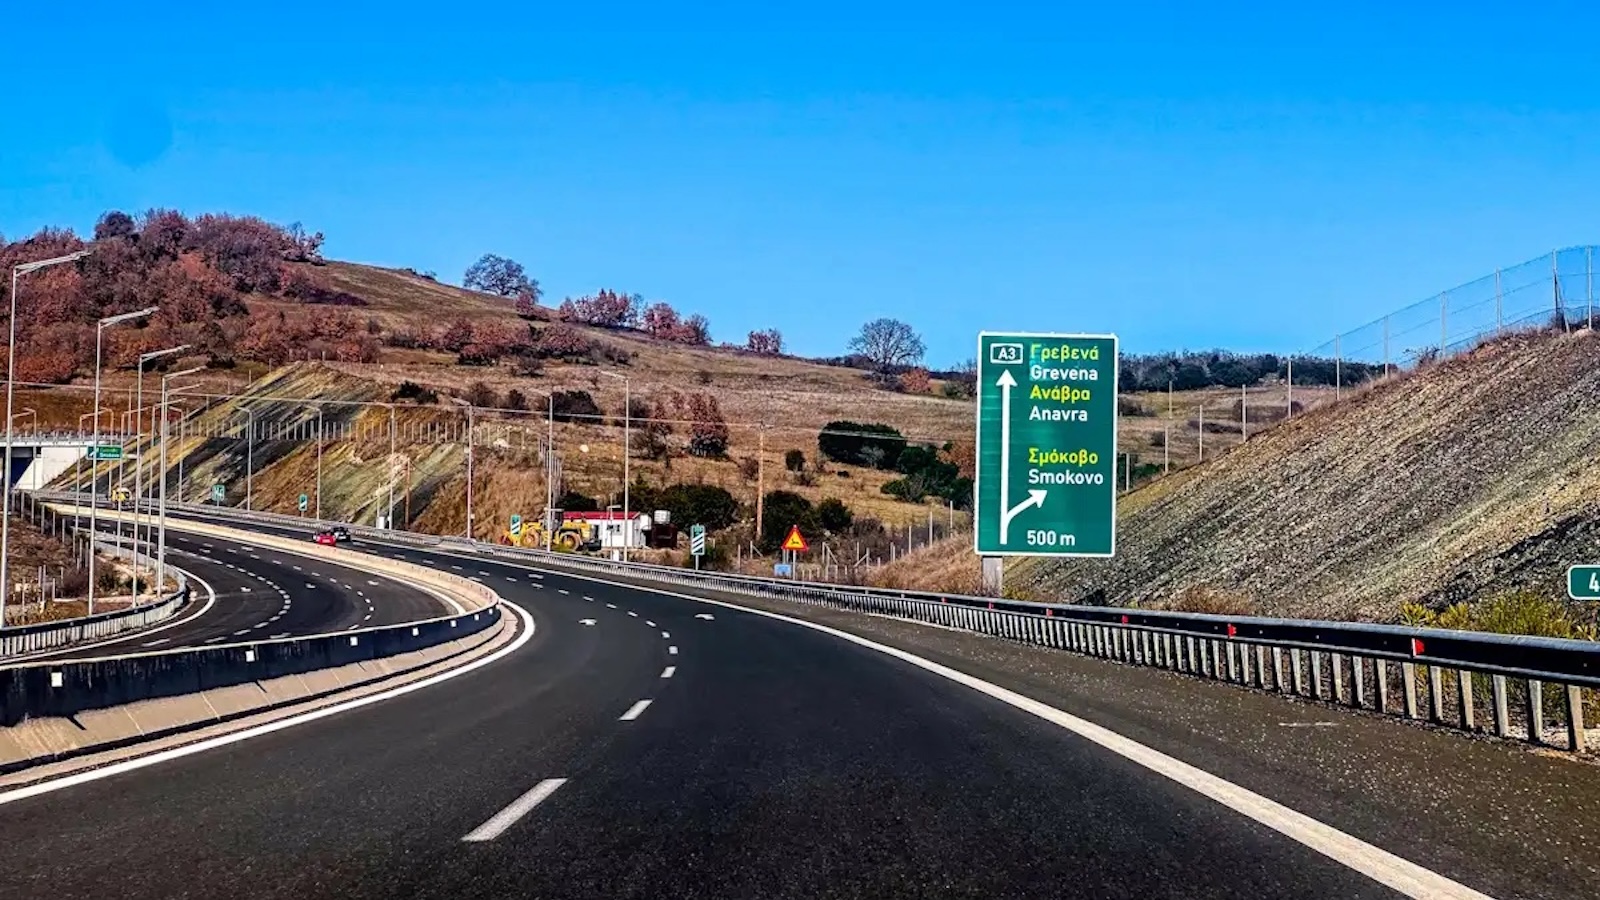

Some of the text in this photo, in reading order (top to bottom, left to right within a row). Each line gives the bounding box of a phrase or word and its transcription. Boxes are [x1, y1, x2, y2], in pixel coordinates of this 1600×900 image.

[998, 347, 1016, 361] A3
[1031, 344, 1099, 364] Γρεβενά
[1030, 365, 1098, 381] Grevena
[1030, 385, 1091, 405] Ανάβρα
[1029, 407, 1088, 422] Anavra
[1029, 448, 1099, 467] Σμόκοβο
[1029, 469, 1104, 485] Smokovo
[1027, 530, 1075, 546] 500 m
